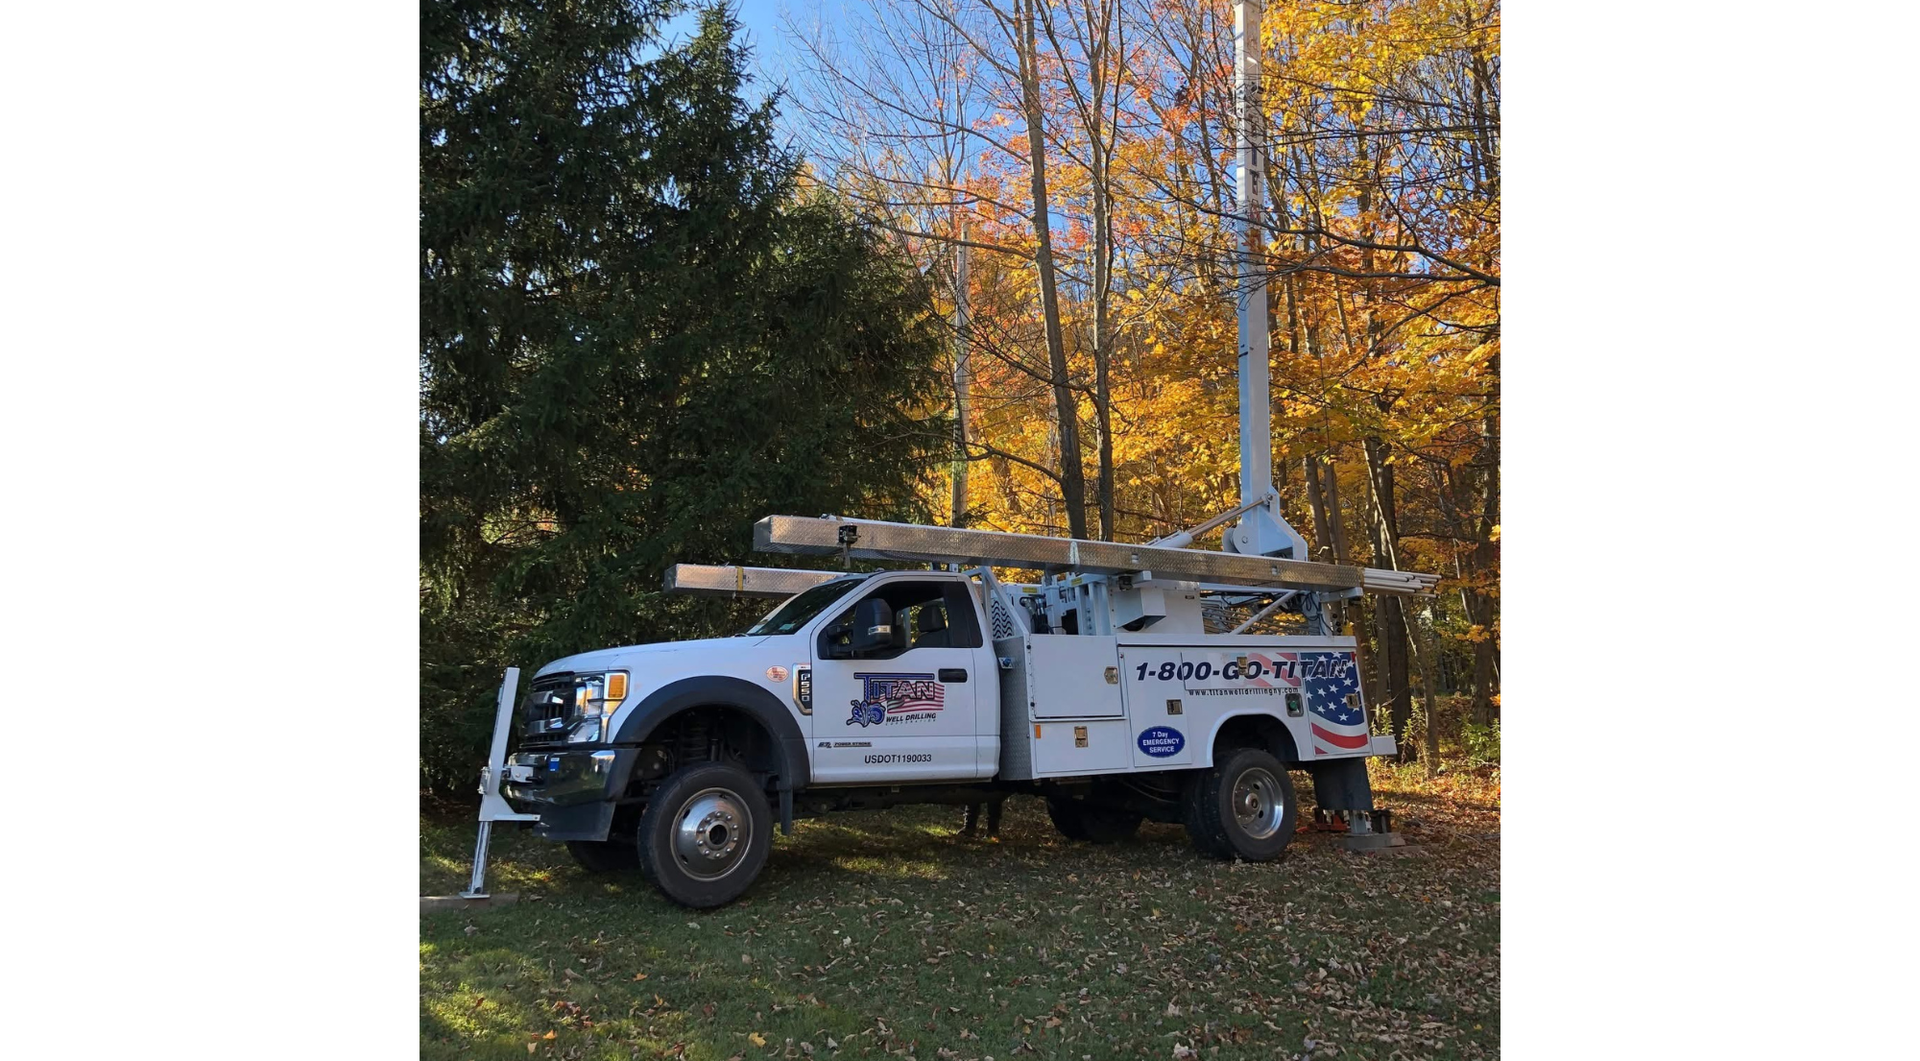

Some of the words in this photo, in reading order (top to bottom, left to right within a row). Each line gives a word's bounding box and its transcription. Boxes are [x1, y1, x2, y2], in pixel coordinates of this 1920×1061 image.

[1136, 660, 1347, 681] 1-800-GO-TITAN
[853, 672, 935, 703] TITAN
[886, 715, 904, 723] WELL
[905, 712, 937, 721] DRILLING
[1157, 730, 1169, 739] Day
[1142, 738, 1179, 746] EMERGENCY
[1149, 745, 1175, 753] SERVICE
[864, 753, 932, 764] USDOT1190033
